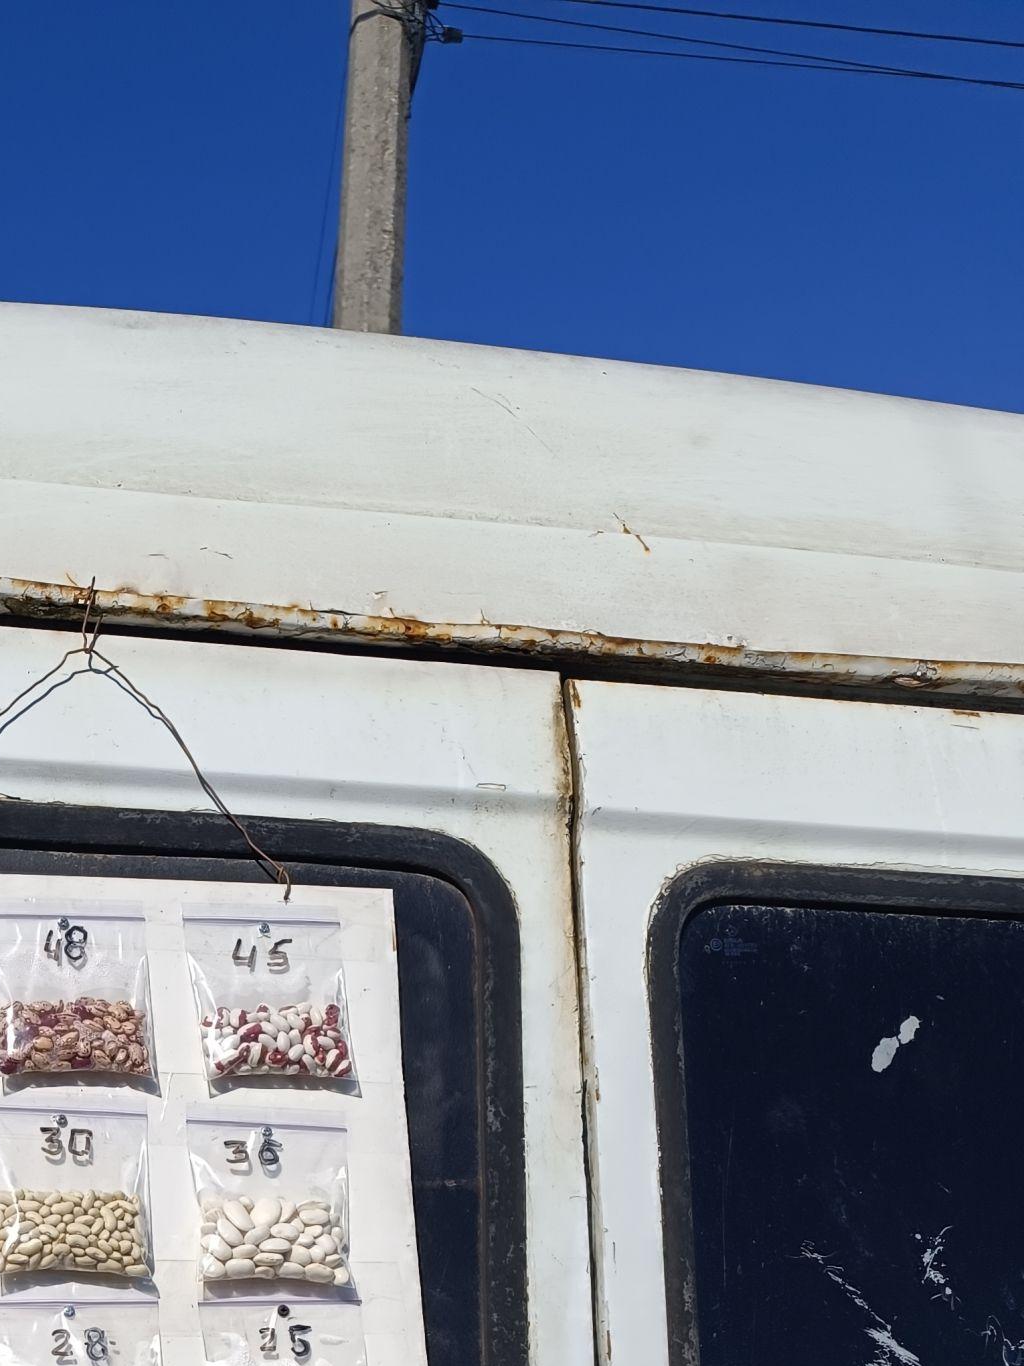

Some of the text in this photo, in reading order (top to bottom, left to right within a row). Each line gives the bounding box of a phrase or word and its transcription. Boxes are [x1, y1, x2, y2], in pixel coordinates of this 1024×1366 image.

[43, 925, 88, 962] 48
[232, 938, 292, 967] 45
[40, 1126, 94, 1157] 30
[224, 1138, 282, 1167] 36
[51, 1327, 108, 1362] 28
[259, 1325, 312, 1358] 25
